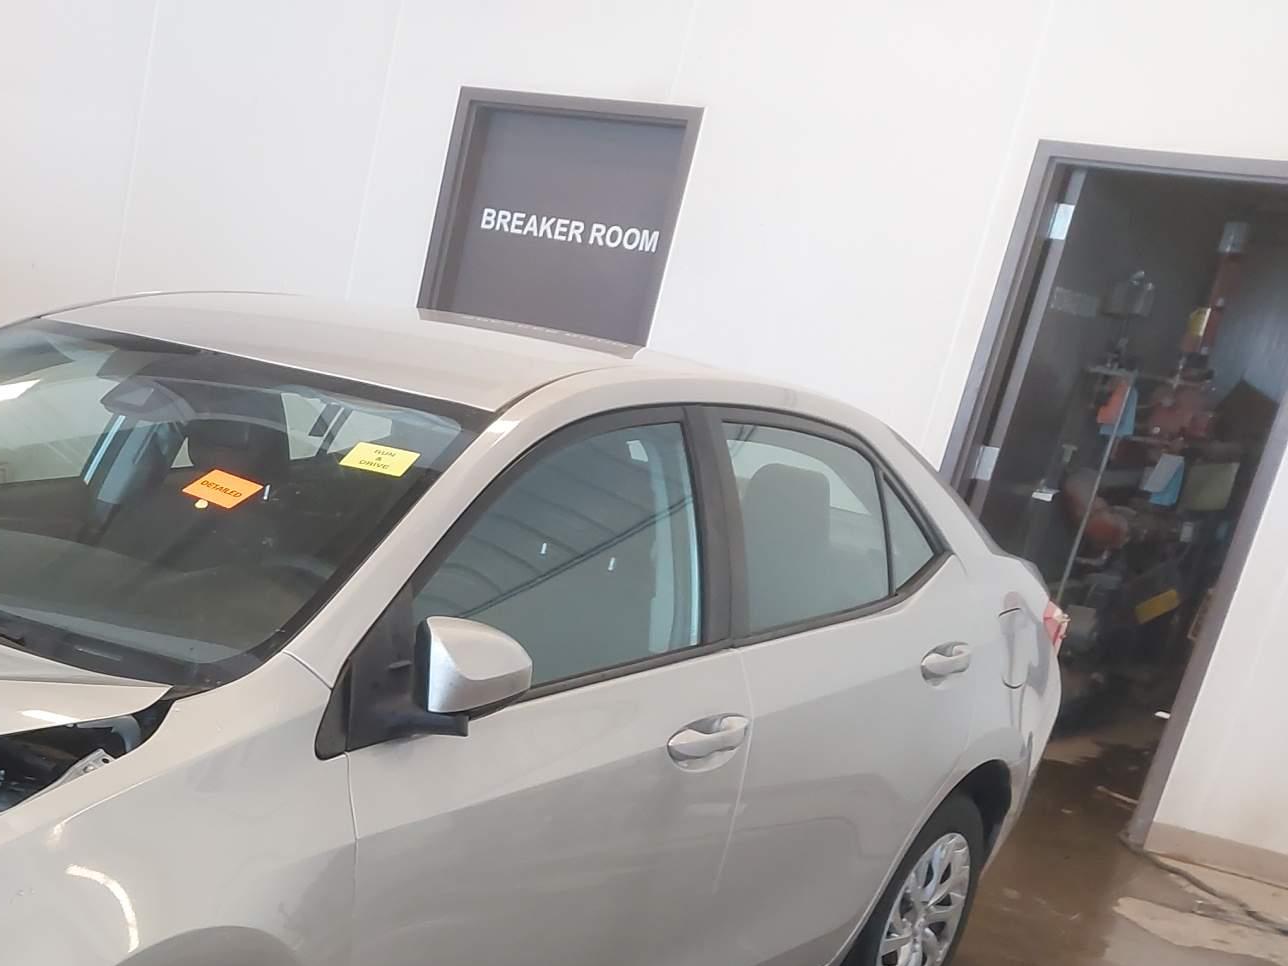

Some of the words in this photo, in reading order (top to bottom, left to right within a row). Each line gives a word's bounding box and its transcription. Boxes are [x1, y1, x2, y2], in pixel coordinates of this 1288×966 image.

[480, 207, 585, 244] BREAKER
[588, 222, 660, 253] ROOM
[373, 448, 397, 458] RUN
[358, 459, 391, 470] DRIVE
[200, 479, 243, 498] DETAILED
